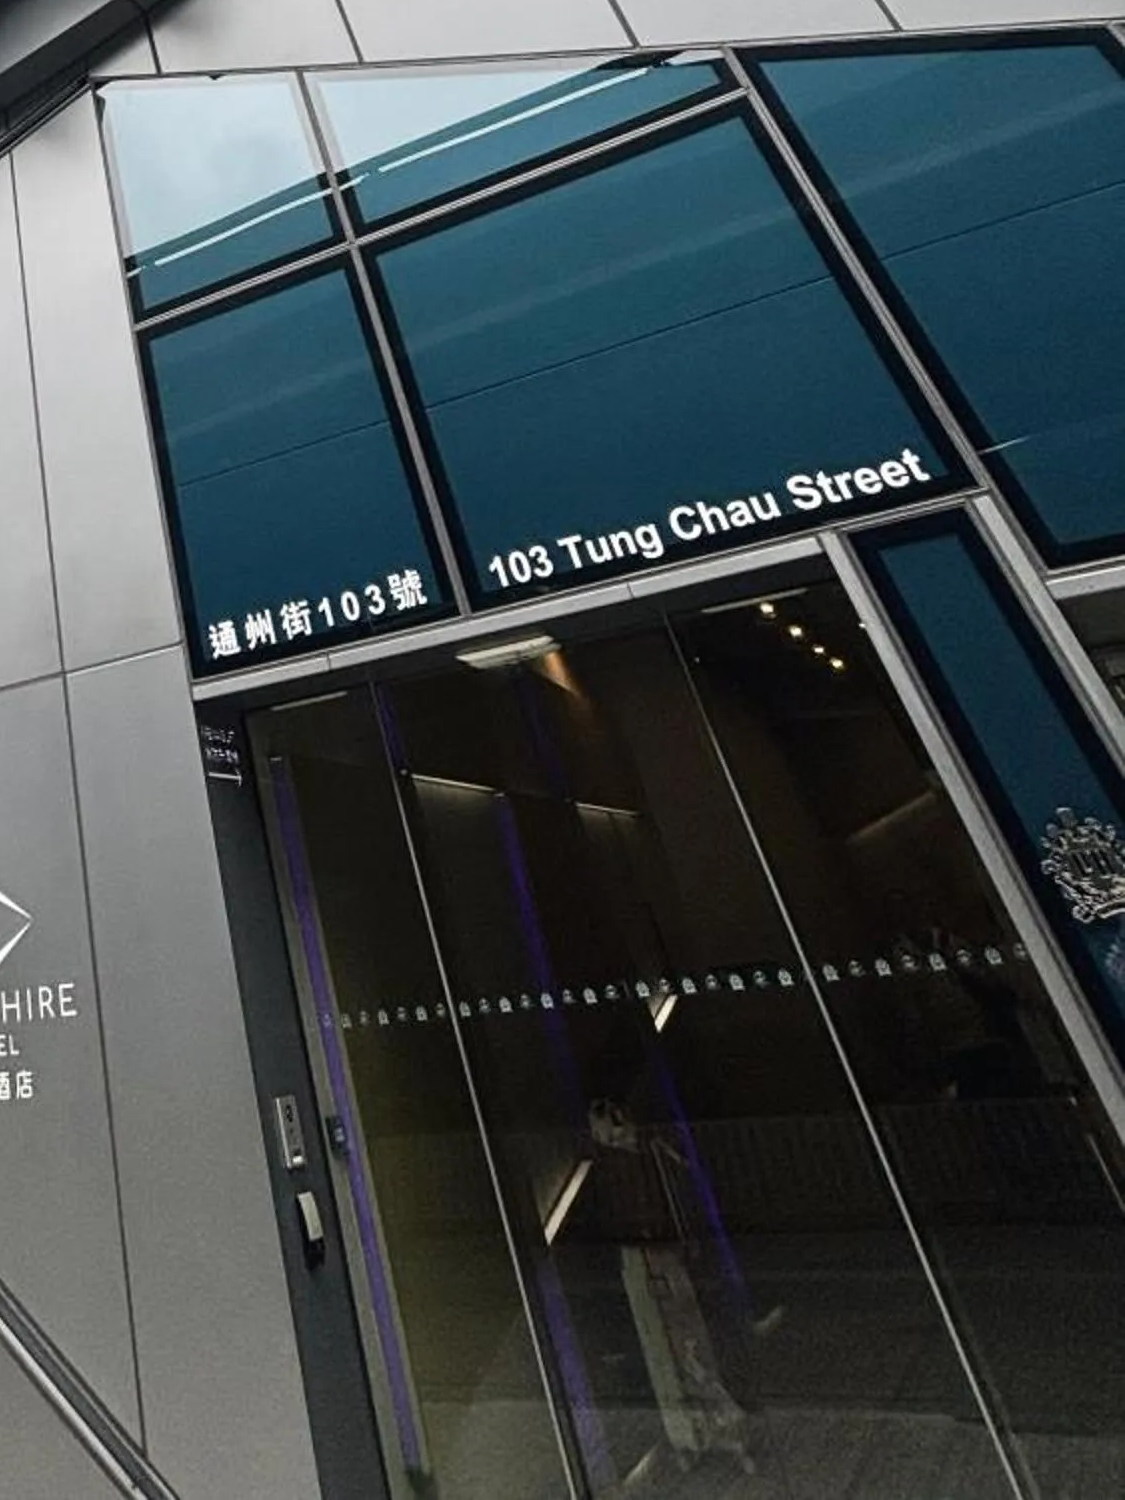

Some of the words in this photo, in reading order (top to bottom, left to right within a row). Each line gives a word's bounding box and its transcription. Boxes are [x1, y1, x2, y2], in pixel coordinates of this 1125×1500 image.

[489, 545, 553, 587] 103
[557, 523, 663, 568] Tung
[669, 492, 781, 540] Chau
[786, 448, 930, 510] Street
